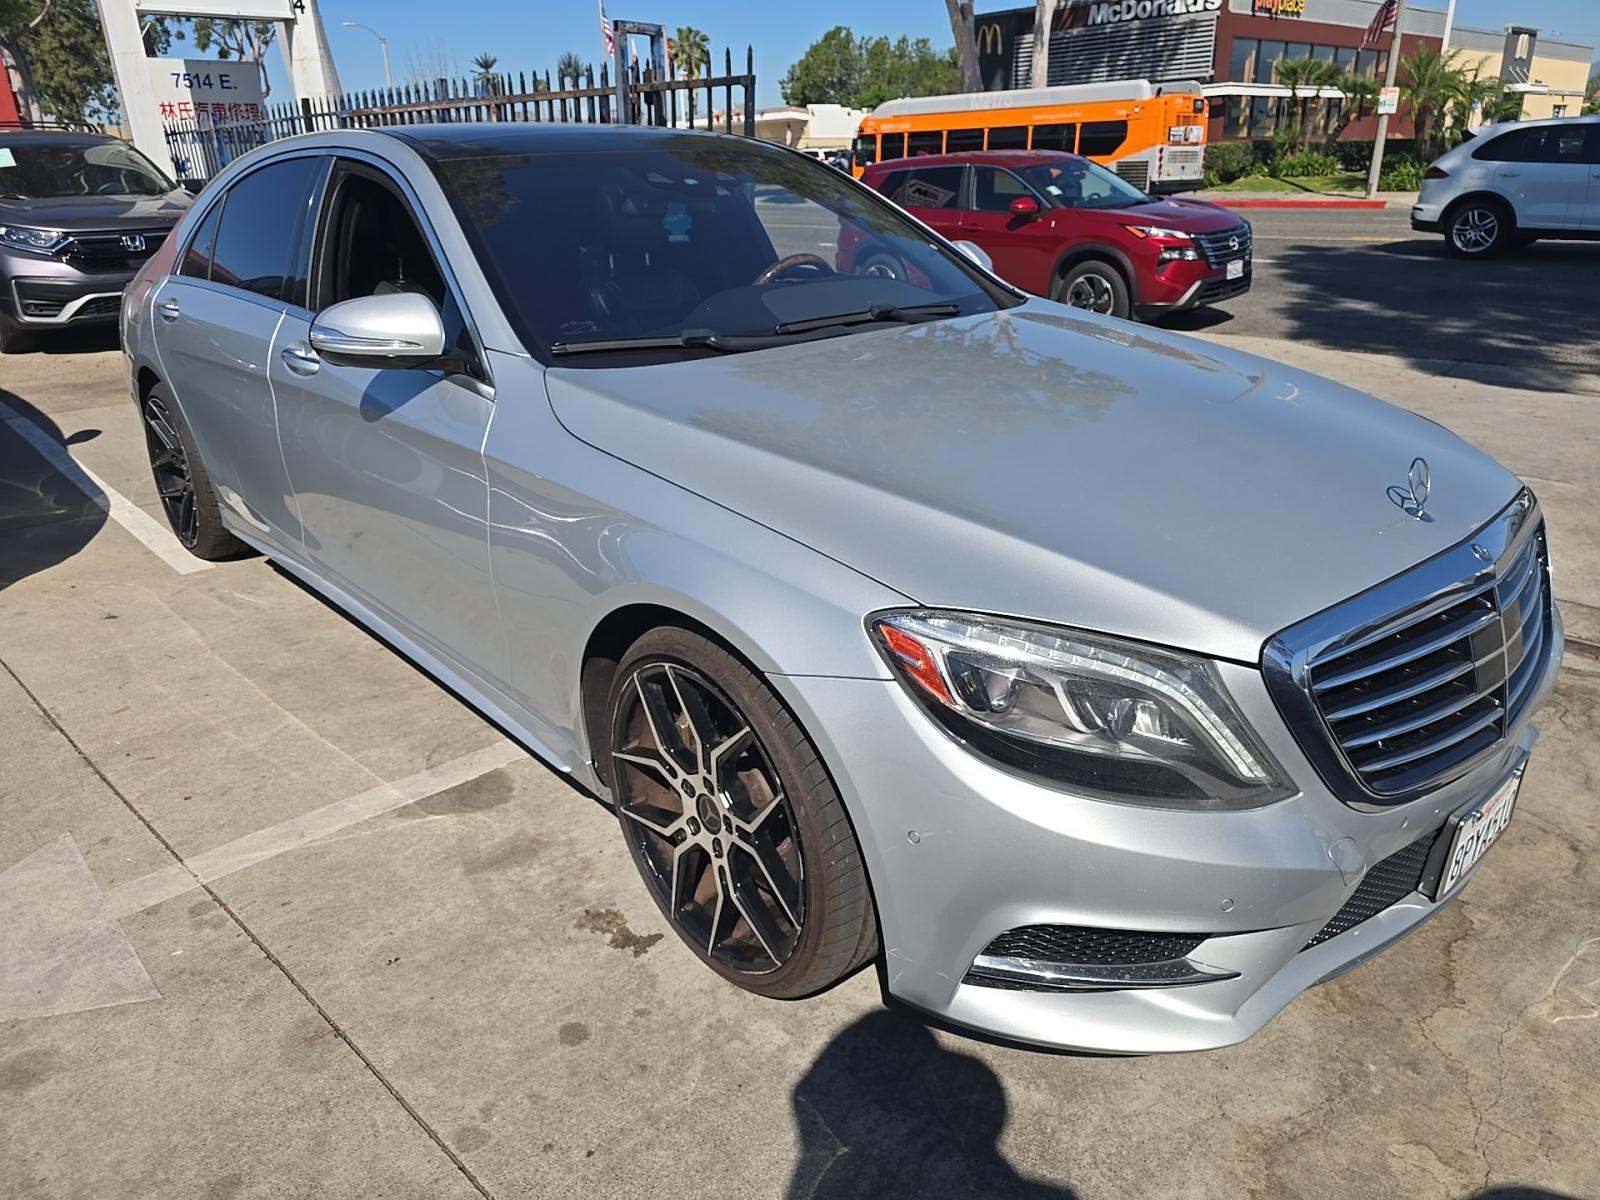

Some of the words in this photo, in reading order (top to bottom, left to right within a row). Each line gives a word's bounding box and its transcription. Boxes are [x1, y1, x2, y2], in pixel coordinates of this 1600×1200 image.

[1087, 0, 1222, 25] McDonalds
[171, 73, 213, 89] 7514
[219, 74, 238, 90] E.
